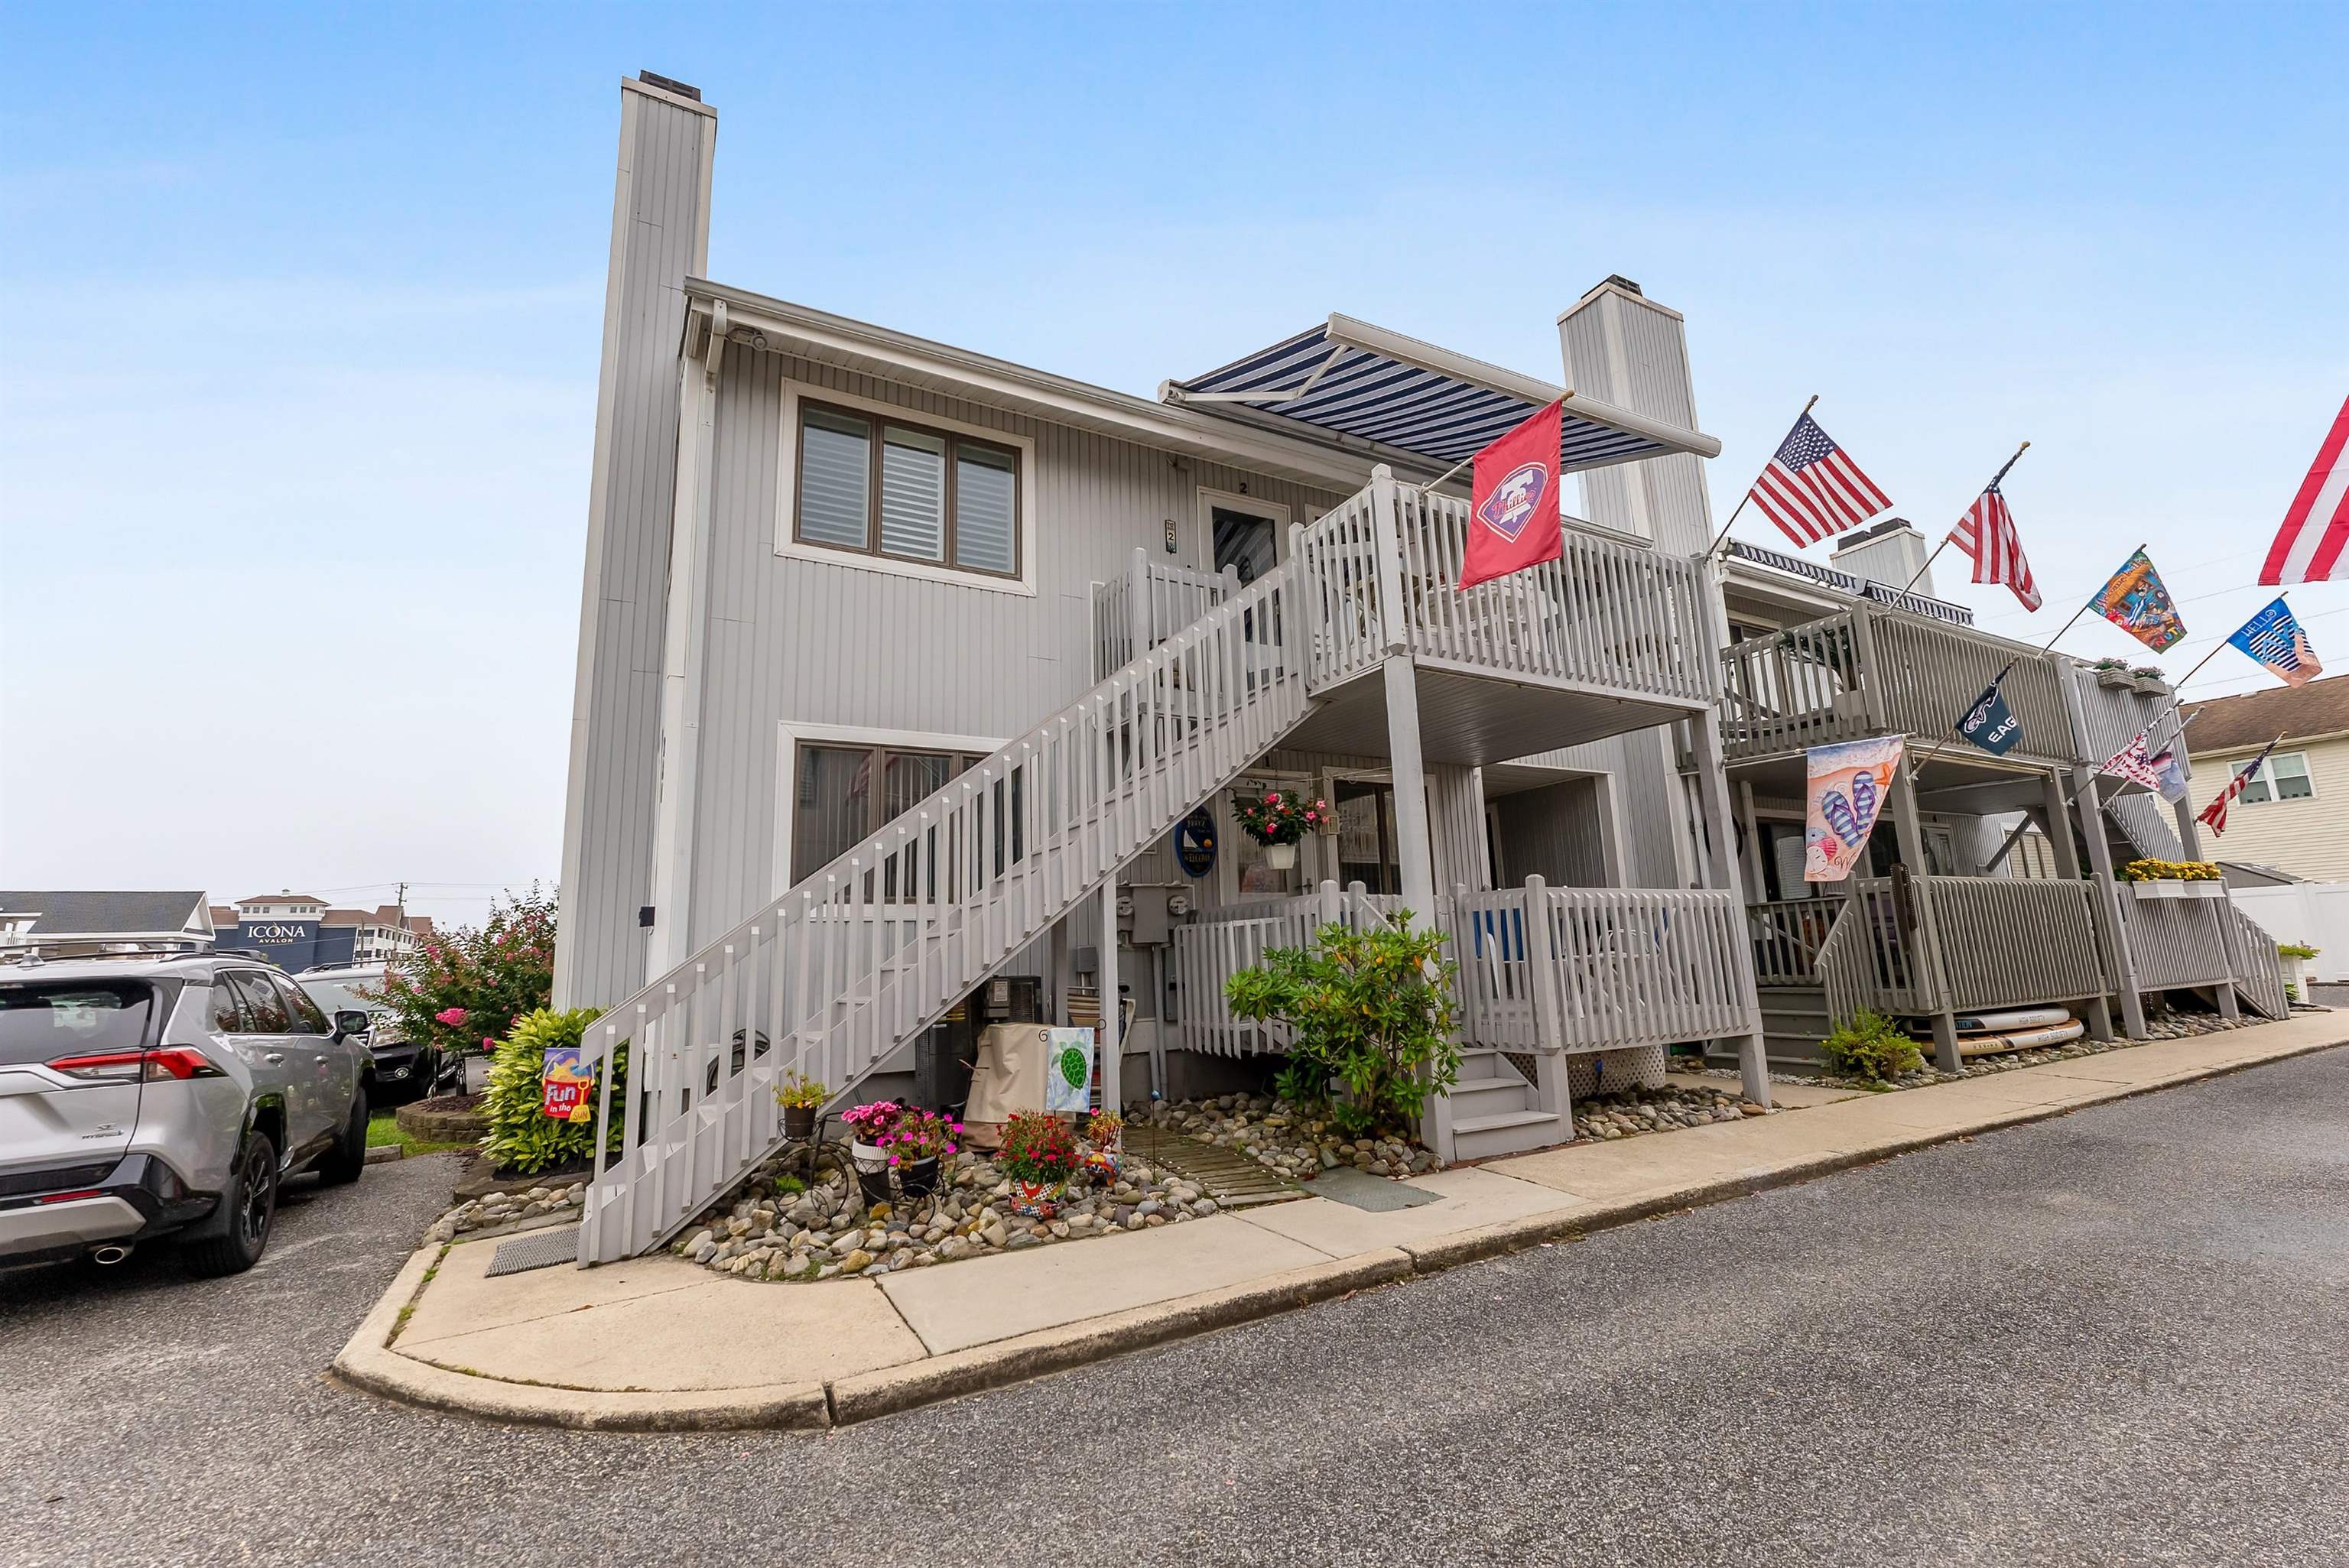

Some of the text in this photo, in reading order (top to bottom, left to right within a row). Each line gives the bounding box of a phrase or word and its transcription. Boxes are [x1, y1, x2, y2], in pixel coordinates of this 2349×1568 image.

[1239, 482, 1247, 494] 2
[2240, 609, 2277, 638] HELLO
[246, 925, 306, 938] ICONA
[545, 1084, 576, 1105] Fun
[559, 1102, 572, 1112] the
[574, 1110, 588, 1120] SUN
